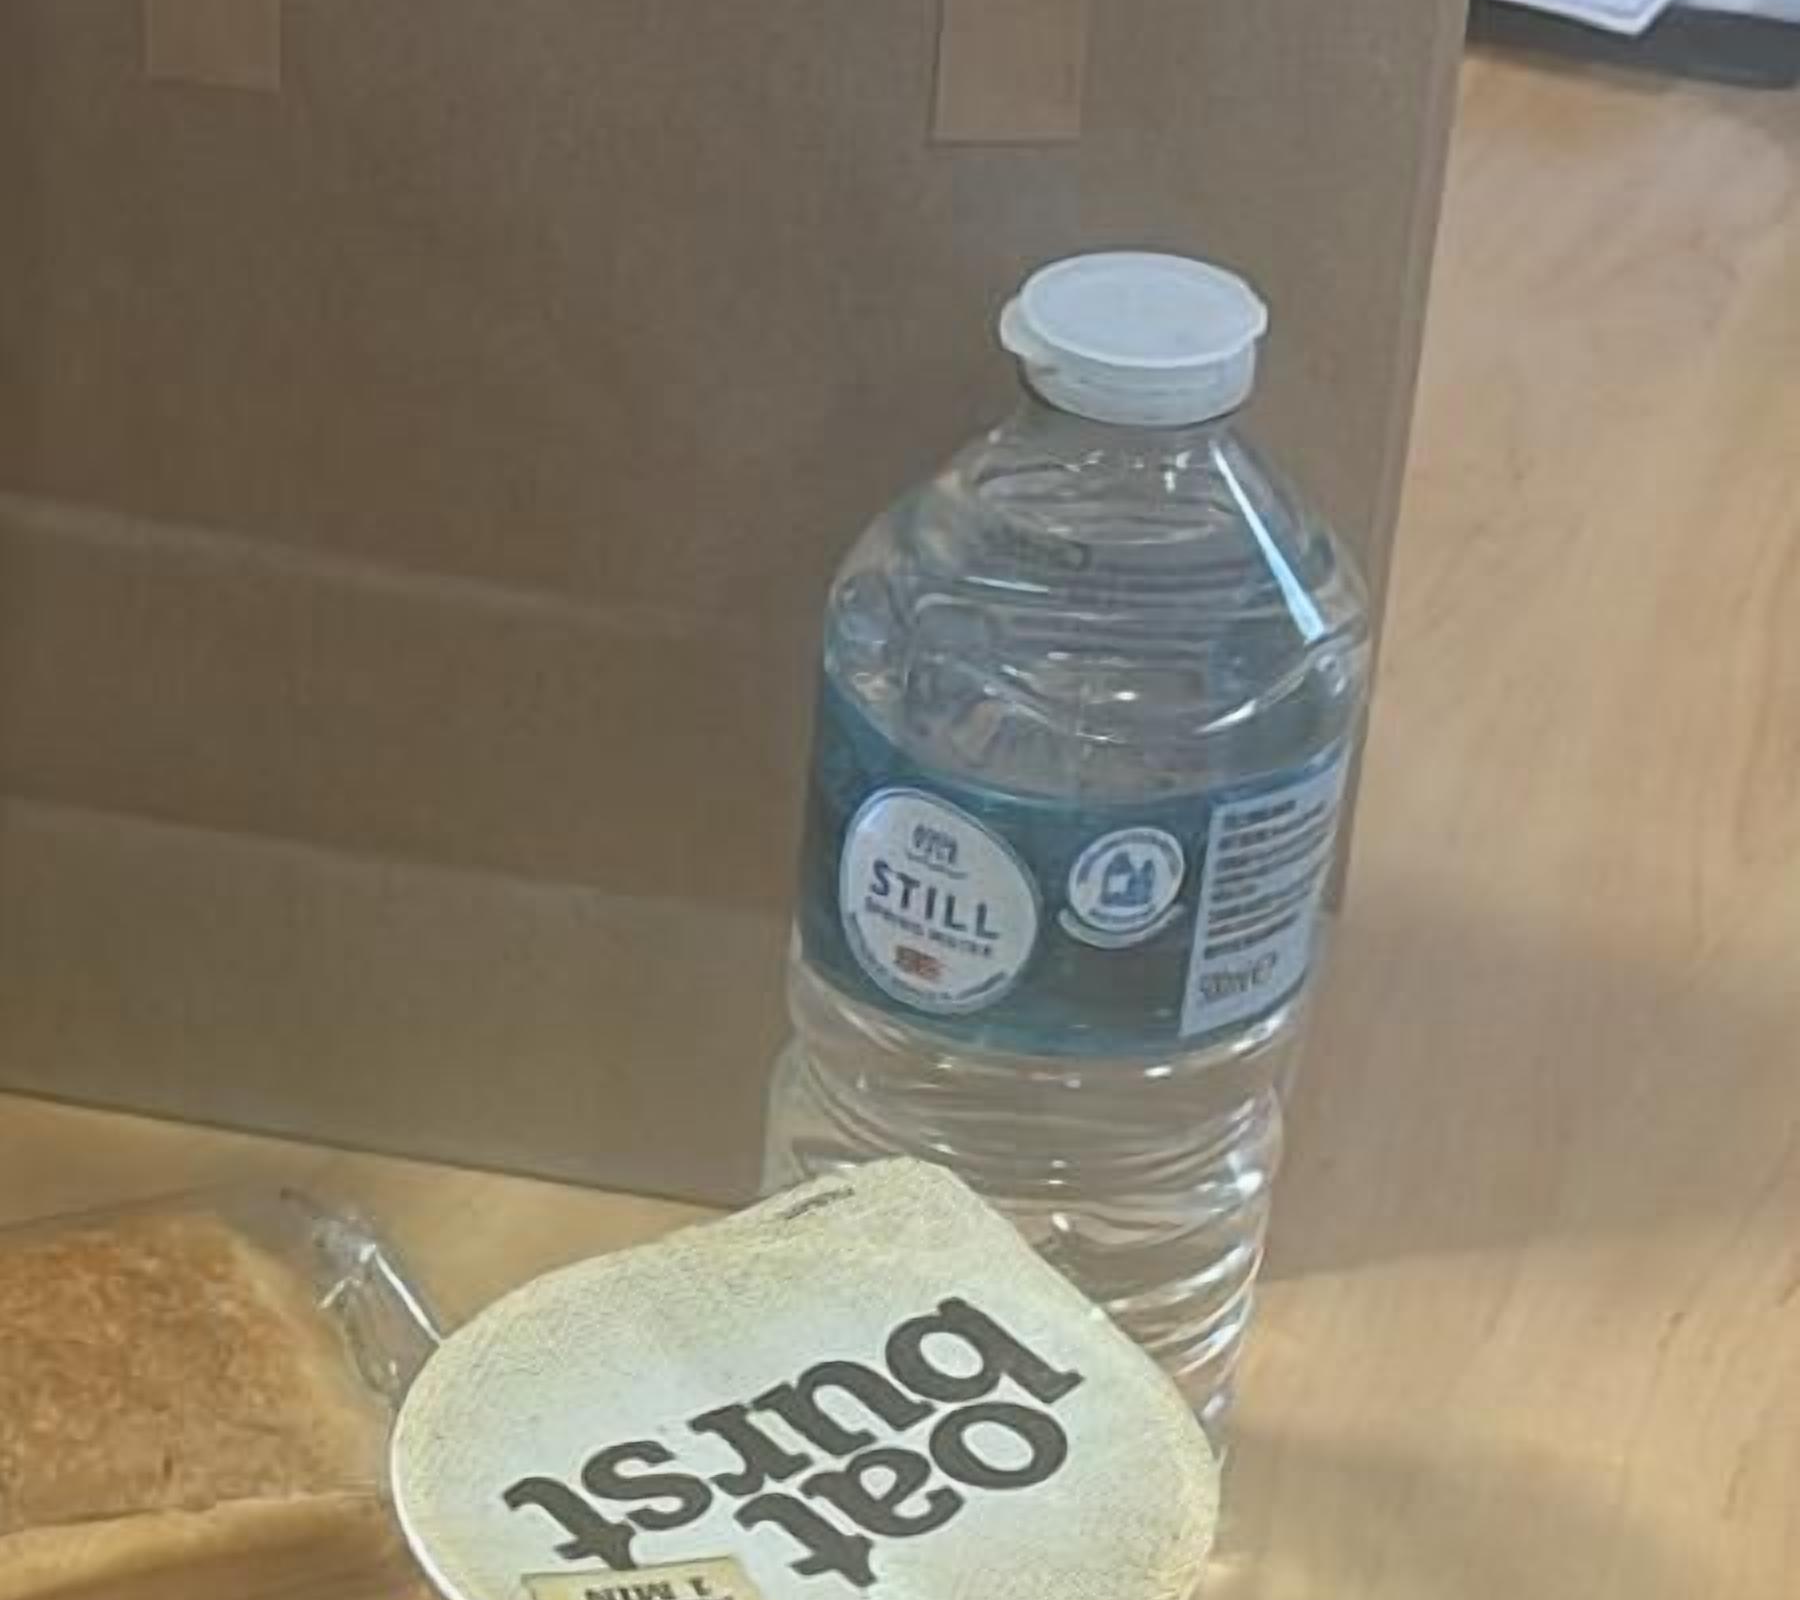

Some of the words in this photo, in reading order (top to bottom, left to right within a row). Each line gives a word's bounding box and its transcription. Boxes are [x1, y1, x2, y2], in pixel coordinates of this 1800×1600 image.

[869, 858, 1001, 941] STILL
[502, 1295, 1085, 1571] burst
[734, 1401, 1069, 1589] oat
